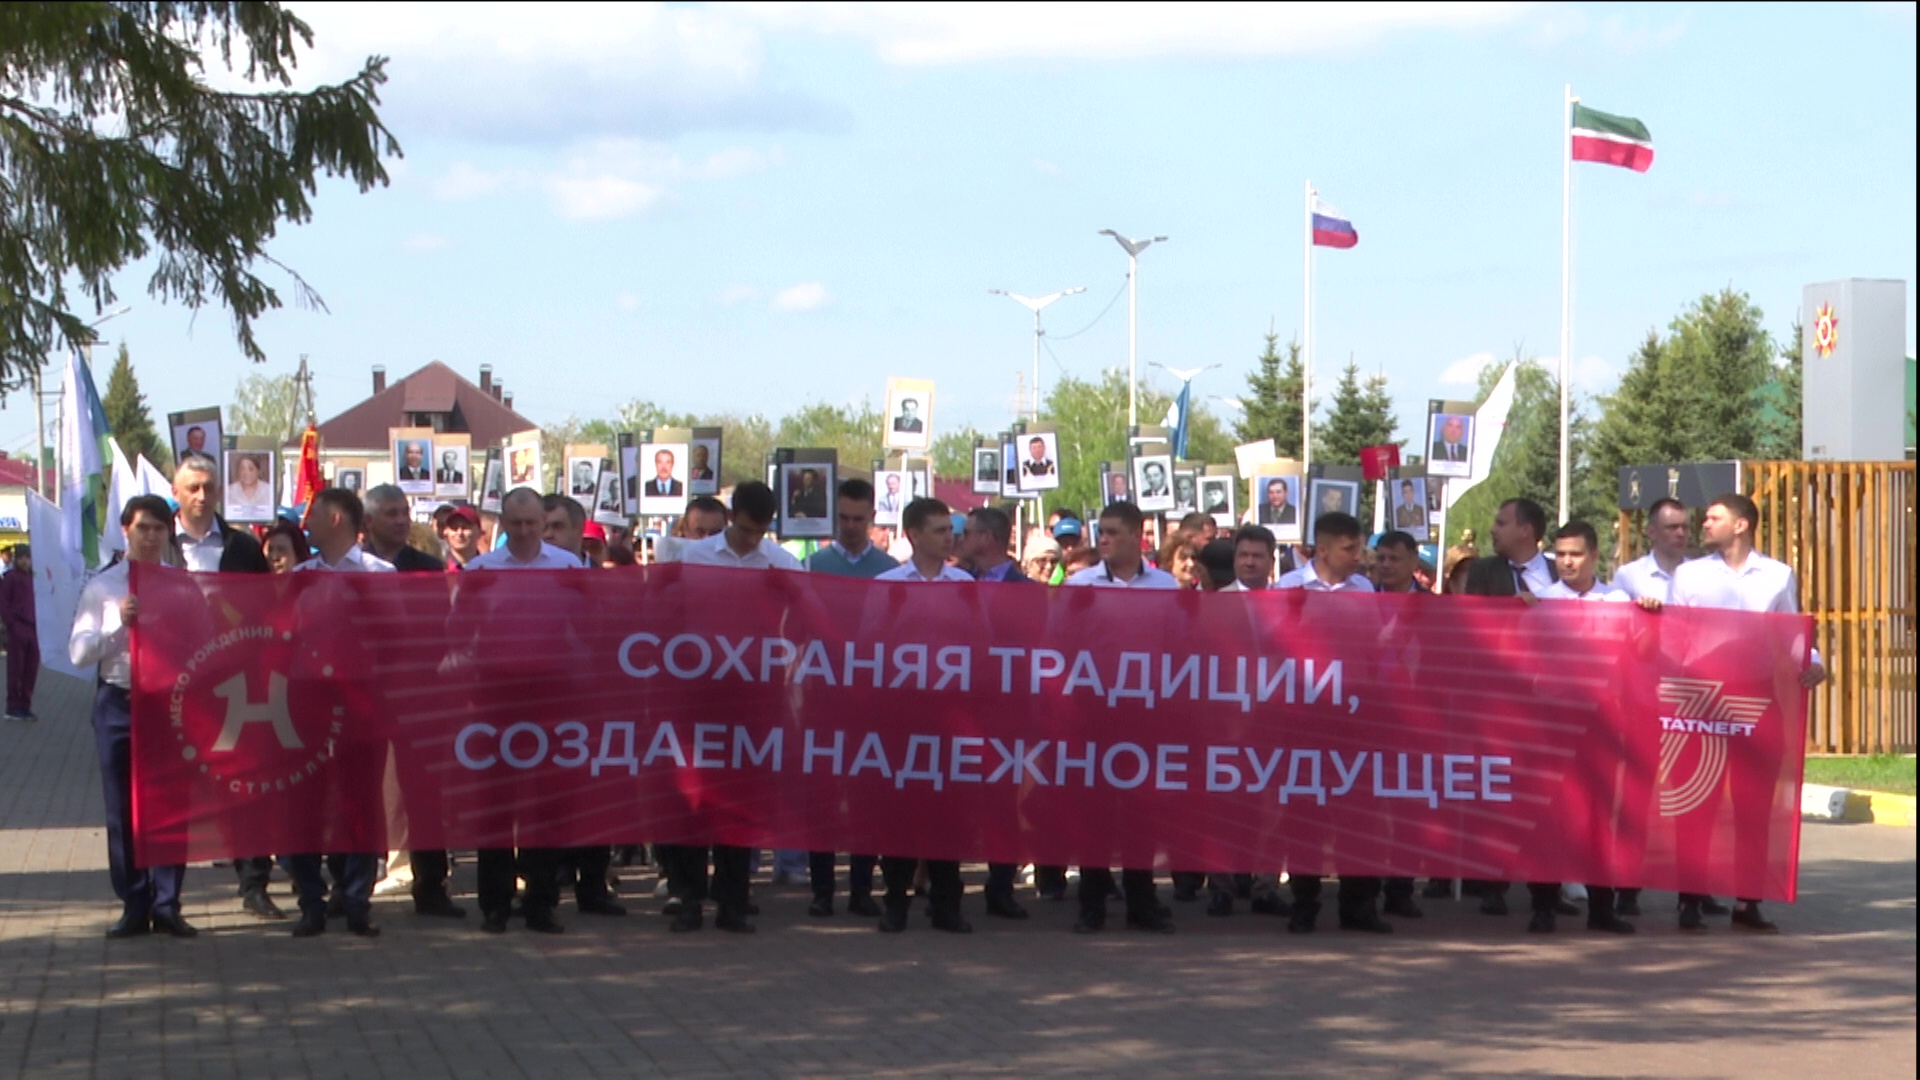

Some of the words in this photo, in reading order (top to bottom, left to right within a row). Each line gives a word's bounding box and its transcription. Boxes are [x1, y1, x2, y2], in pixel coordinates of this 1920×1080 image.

[170, 672, 190, 727] МЕСТО
[187, 626, 273, 671] РОЖДЕНИЯ
[618, 632, 971, 692] СОХРАНЯЯ
[989, 646, 1360, 714] ТРАДИЦИИ,
[454, 721, 784, 777] СОЗДАЕМ
[802, 729, 1189, 791] НАДЕЖНОЕ
[1205, 745, 1513, 809] БУДУЩЕЕ
[1659, 716, 1756, 737] TATNEFT
